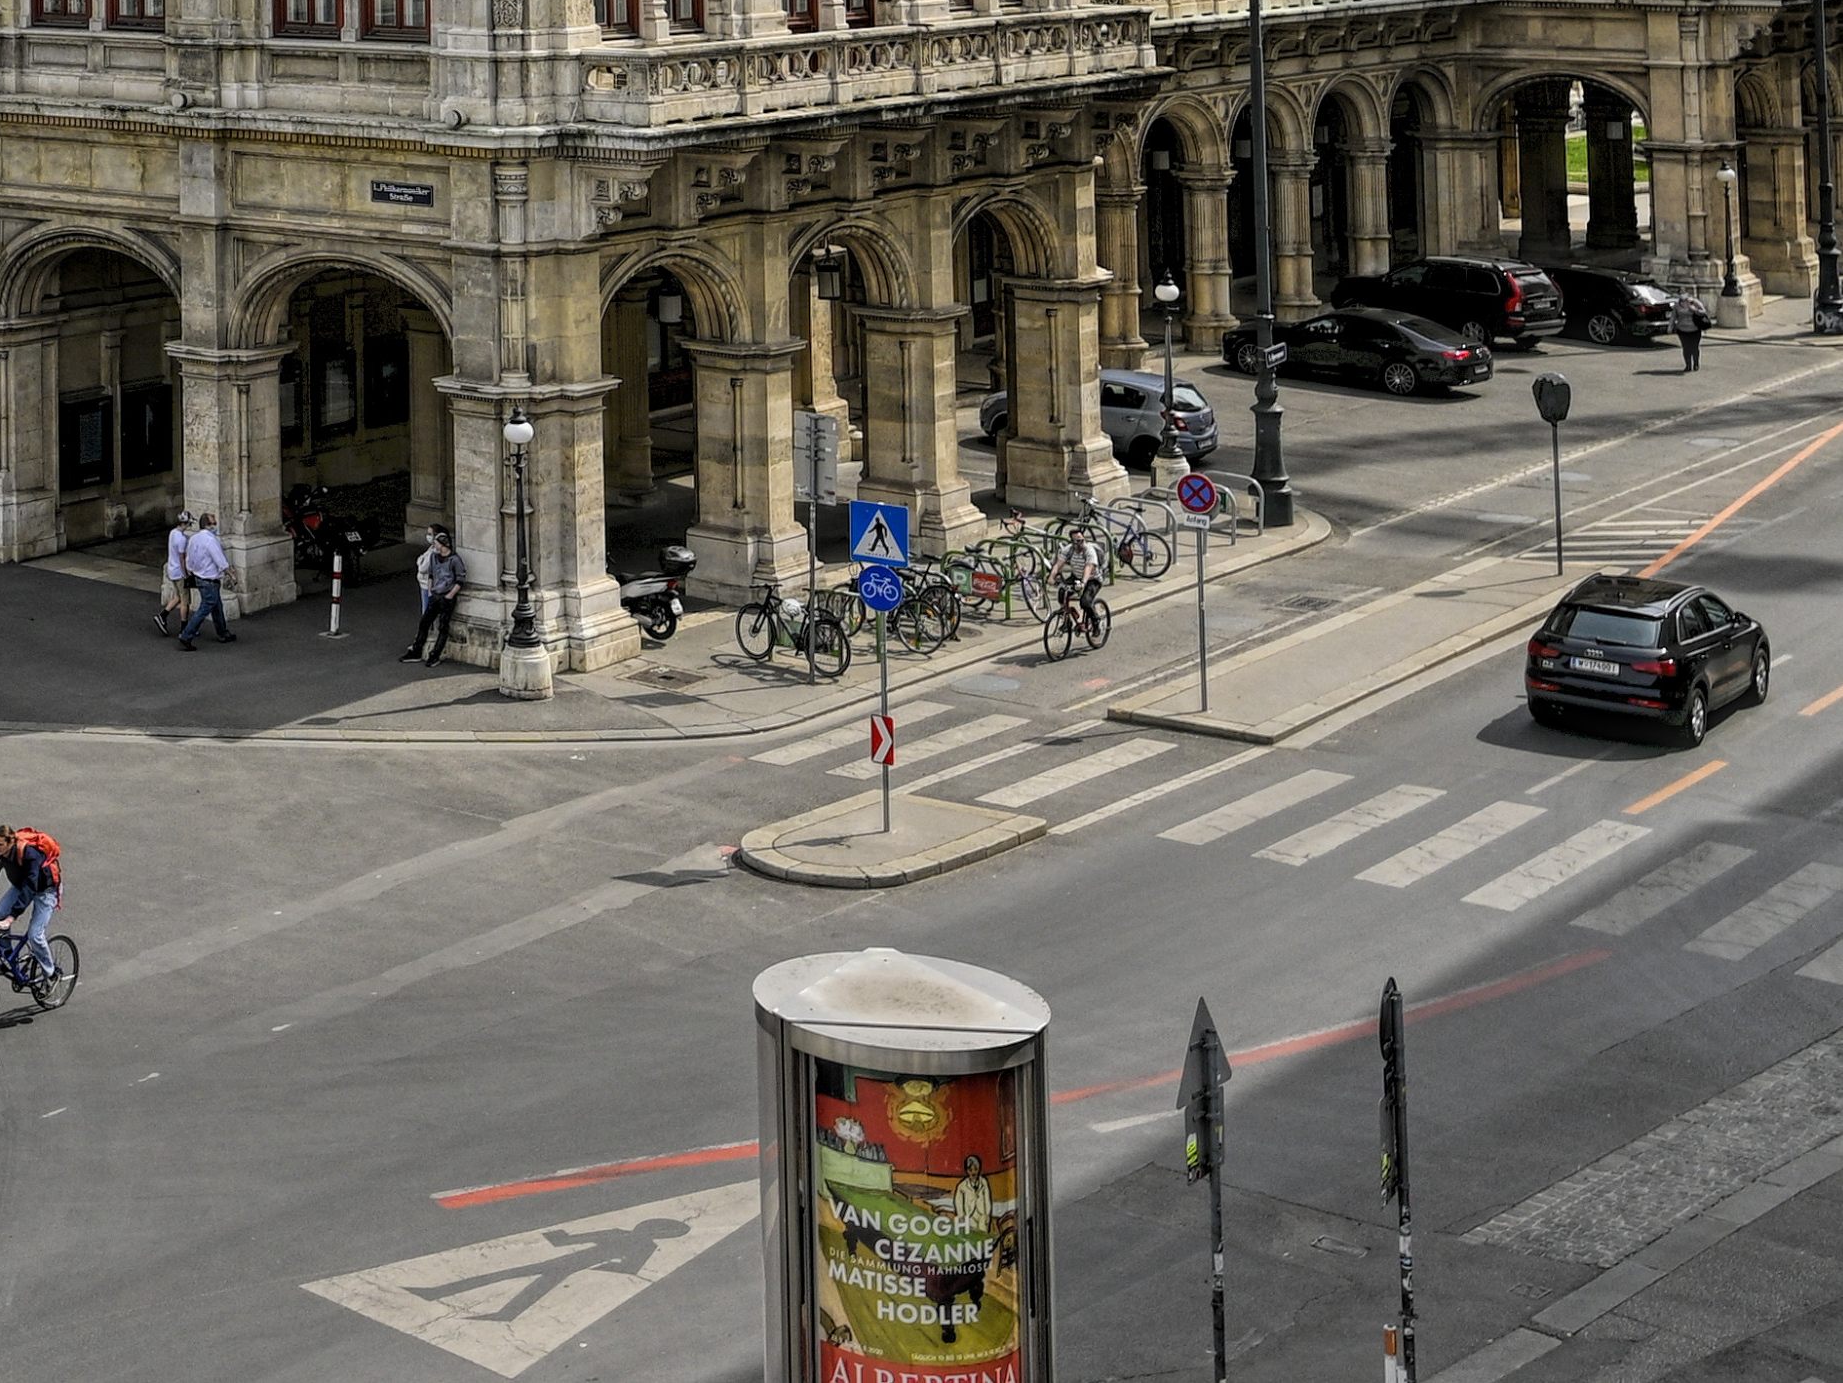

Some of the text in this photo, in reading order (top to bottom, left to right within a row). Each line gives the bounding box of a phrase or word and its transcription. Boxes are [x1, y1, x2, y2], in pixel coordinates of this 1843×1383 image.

[828, 1199, 970, 1236] VAN GOGH
[829, 1247, 846, 1260] DIE
[850, 1253, 922, 1275] SAMMLUNG
[874, 1236, 995, 1264] CÉZANNE
[828, 1259, 927, 1298] MATISSE
[876, 1300, 980, 1326] HODLER
